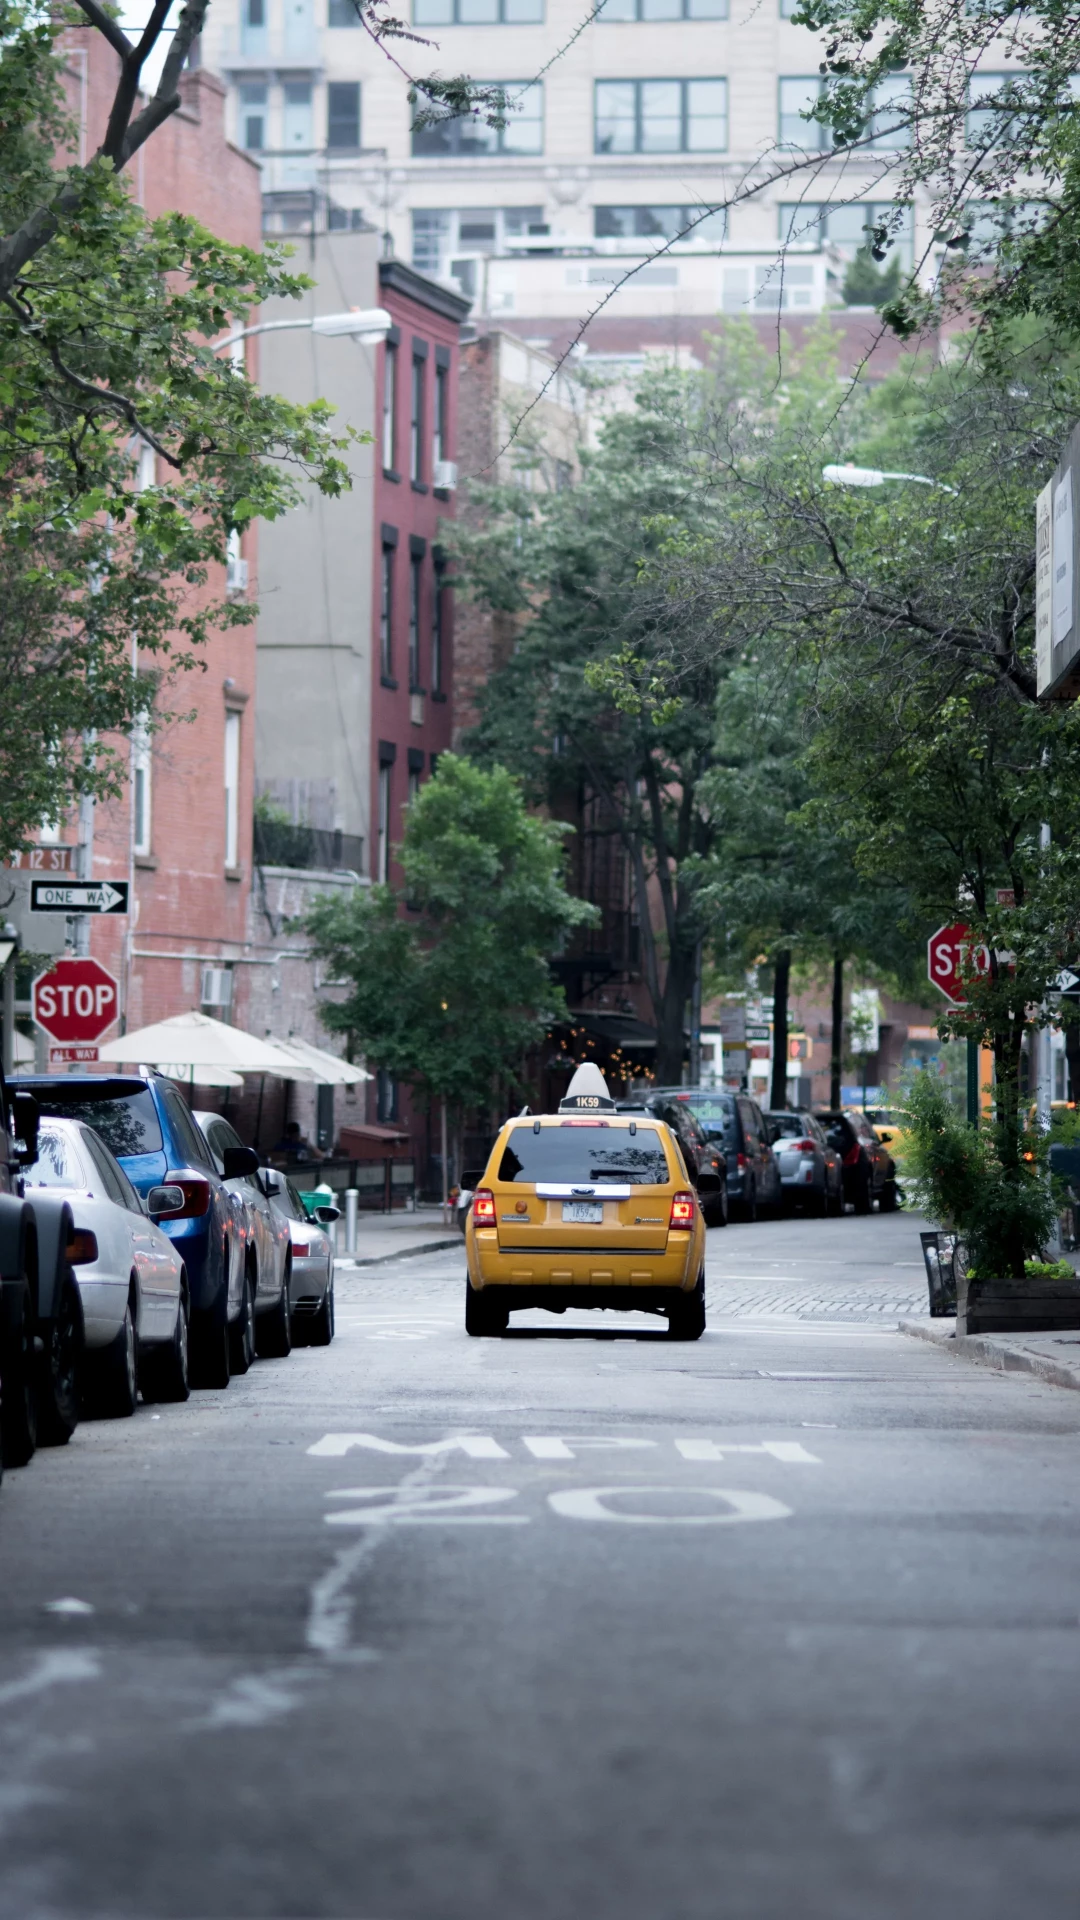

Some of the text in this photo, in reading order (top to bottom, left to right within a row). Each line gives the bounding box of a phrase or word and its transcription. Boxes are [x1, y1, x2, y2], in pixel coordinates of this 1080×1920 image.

[30, 850, 44, 869] 12
[51, 850, 67, 870] ST
[45, 890, 114, 903] ONE WAY
[935, 944, 991, 976] STO
[38, 985, 114, 1017] STOP
[76, 1049, 96, 1060] WAY
[576, 1096, 599, 1108] 1K59
[306, 1432, 823, 1463] MPH
[323, 1485, 794, 1525] 20
